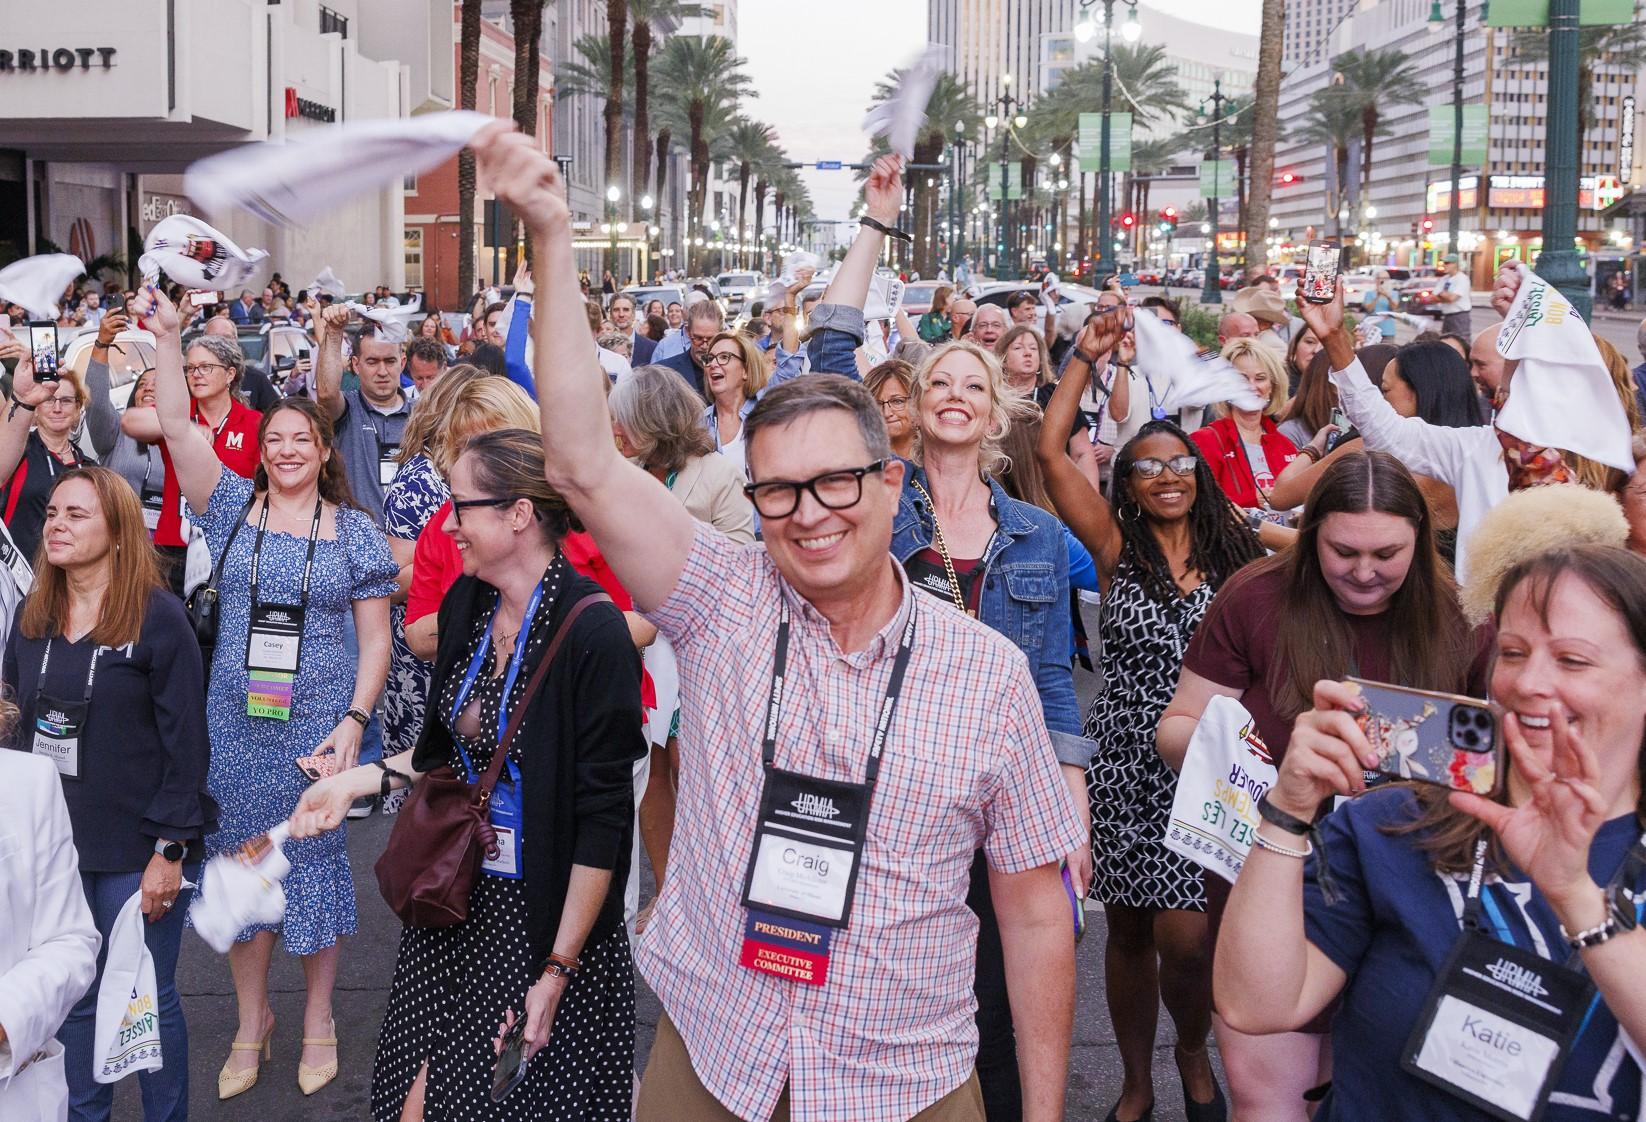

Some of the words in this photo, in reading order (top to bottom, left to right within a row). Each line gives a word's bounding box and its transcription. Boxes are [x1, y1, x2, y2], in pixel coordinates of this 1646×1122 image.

[226, 431, 244, 448] M
[263, 641, 284, 650] Casey
[267, 708, 284, 717] PRO
[35, 738, 72, 754] Jennifer
[795, 792, 836, 818] URMIA
[1202, 800, 1226, 829] LES
[782, 848, 829, 877] Craig
[754, 921, 821, 944] PRESIDENT
[753, 958, 814, 980] COMMITTEE
[758, 949, 813, 969] EXECUTIVE
[1461, 1015, 1522, 1057] Katie
